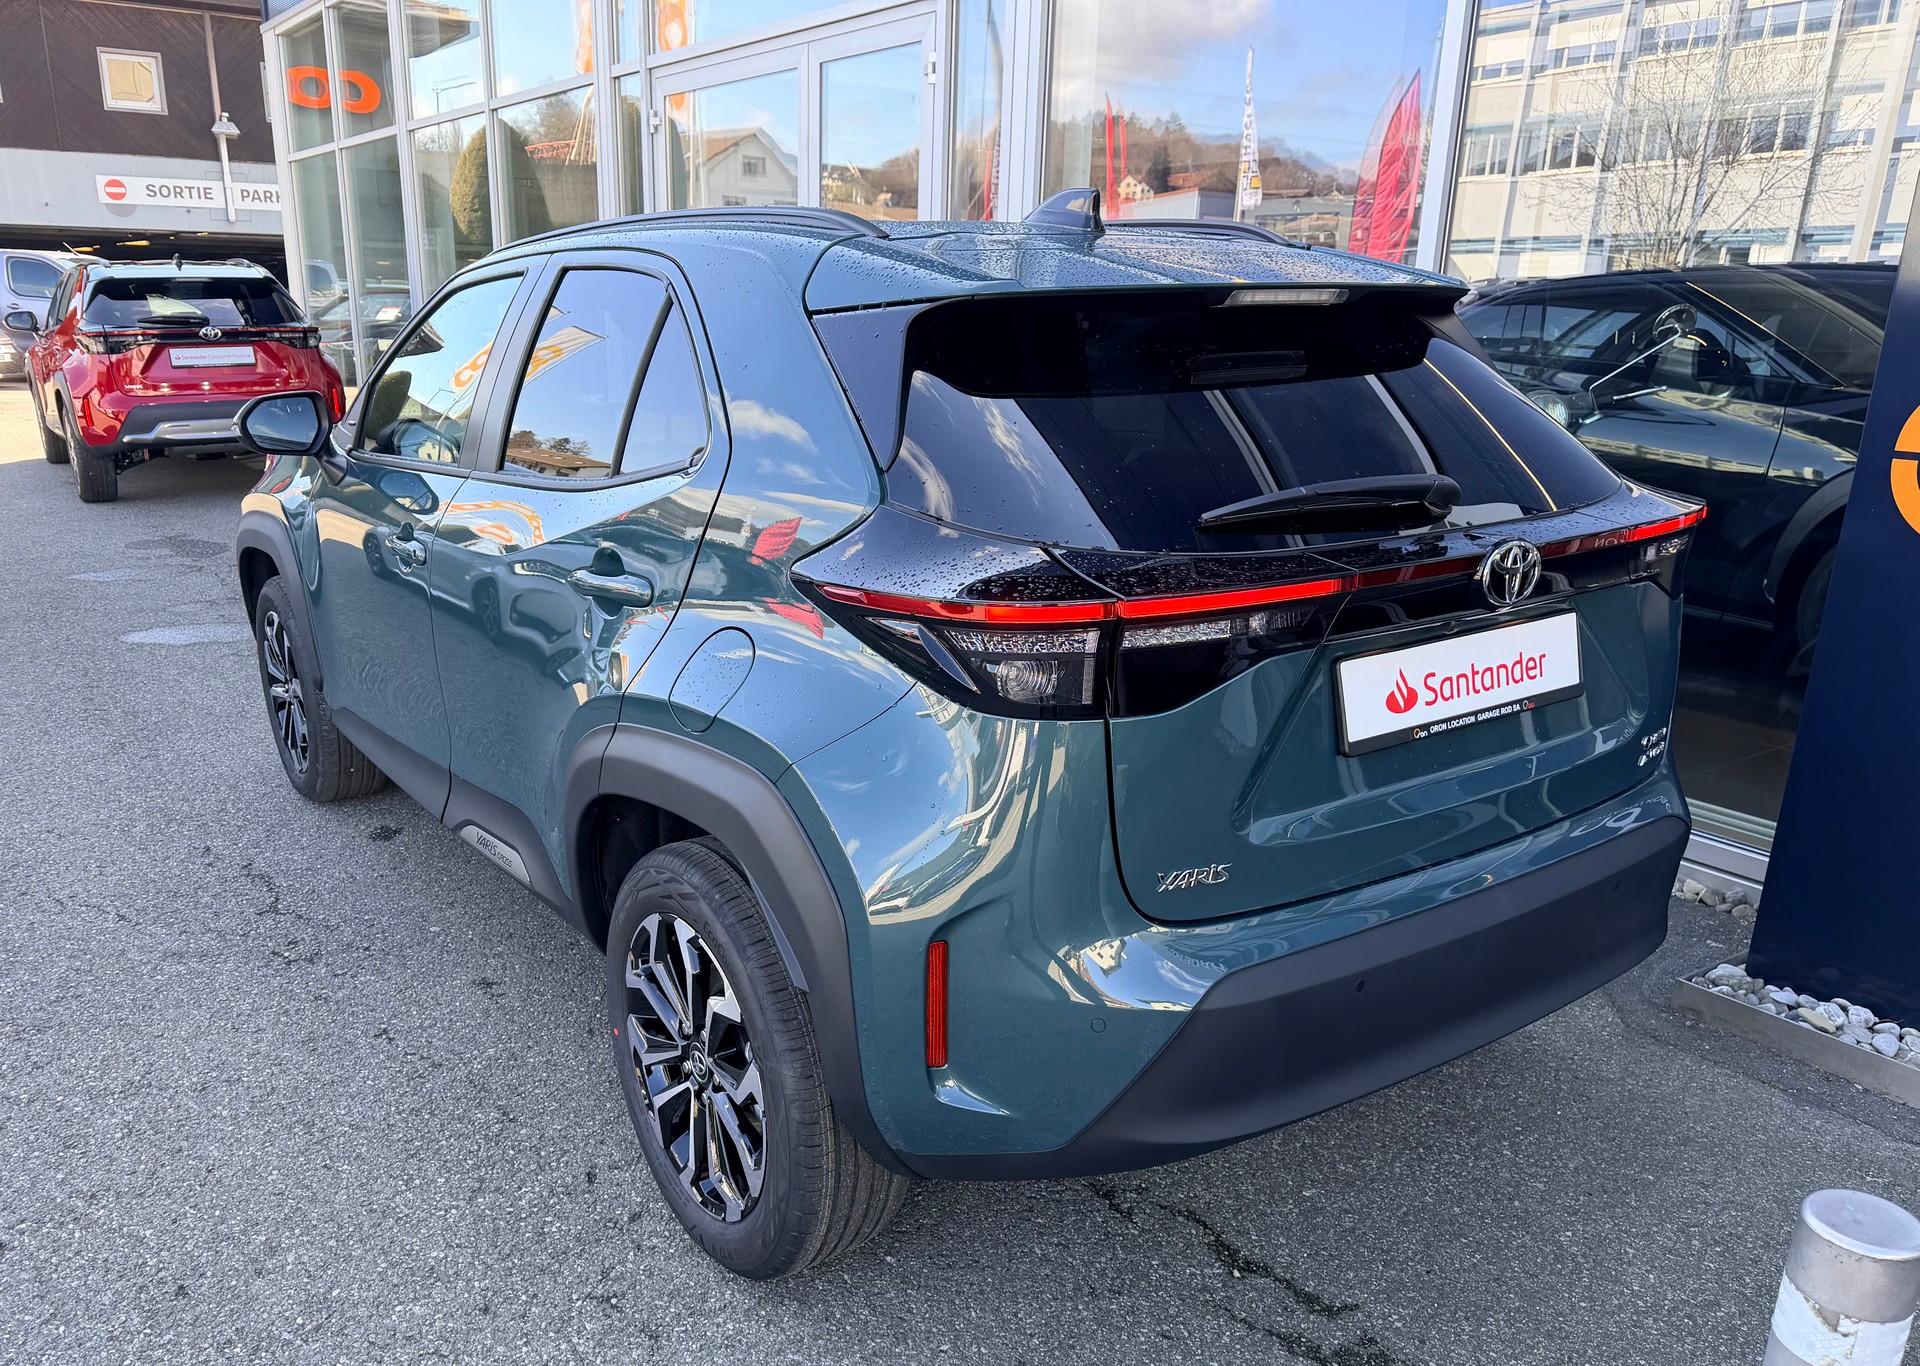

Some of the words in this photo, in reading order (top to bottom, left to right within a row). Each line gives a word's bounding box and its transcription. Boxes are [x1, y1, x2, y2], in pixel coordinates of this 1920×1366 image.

[145, 184, 214, 200] SORTIE
[1423, 651, 1547, 706] Santander
[1429, 722, 1447, 734] ORON
[1447, 715, 1476, 729] LOCATION
[1477, 708, 1500, 721] GARAGE
[1500, 705, 1513, 715] ROD
[1512, 703, 1521, 712] SA
